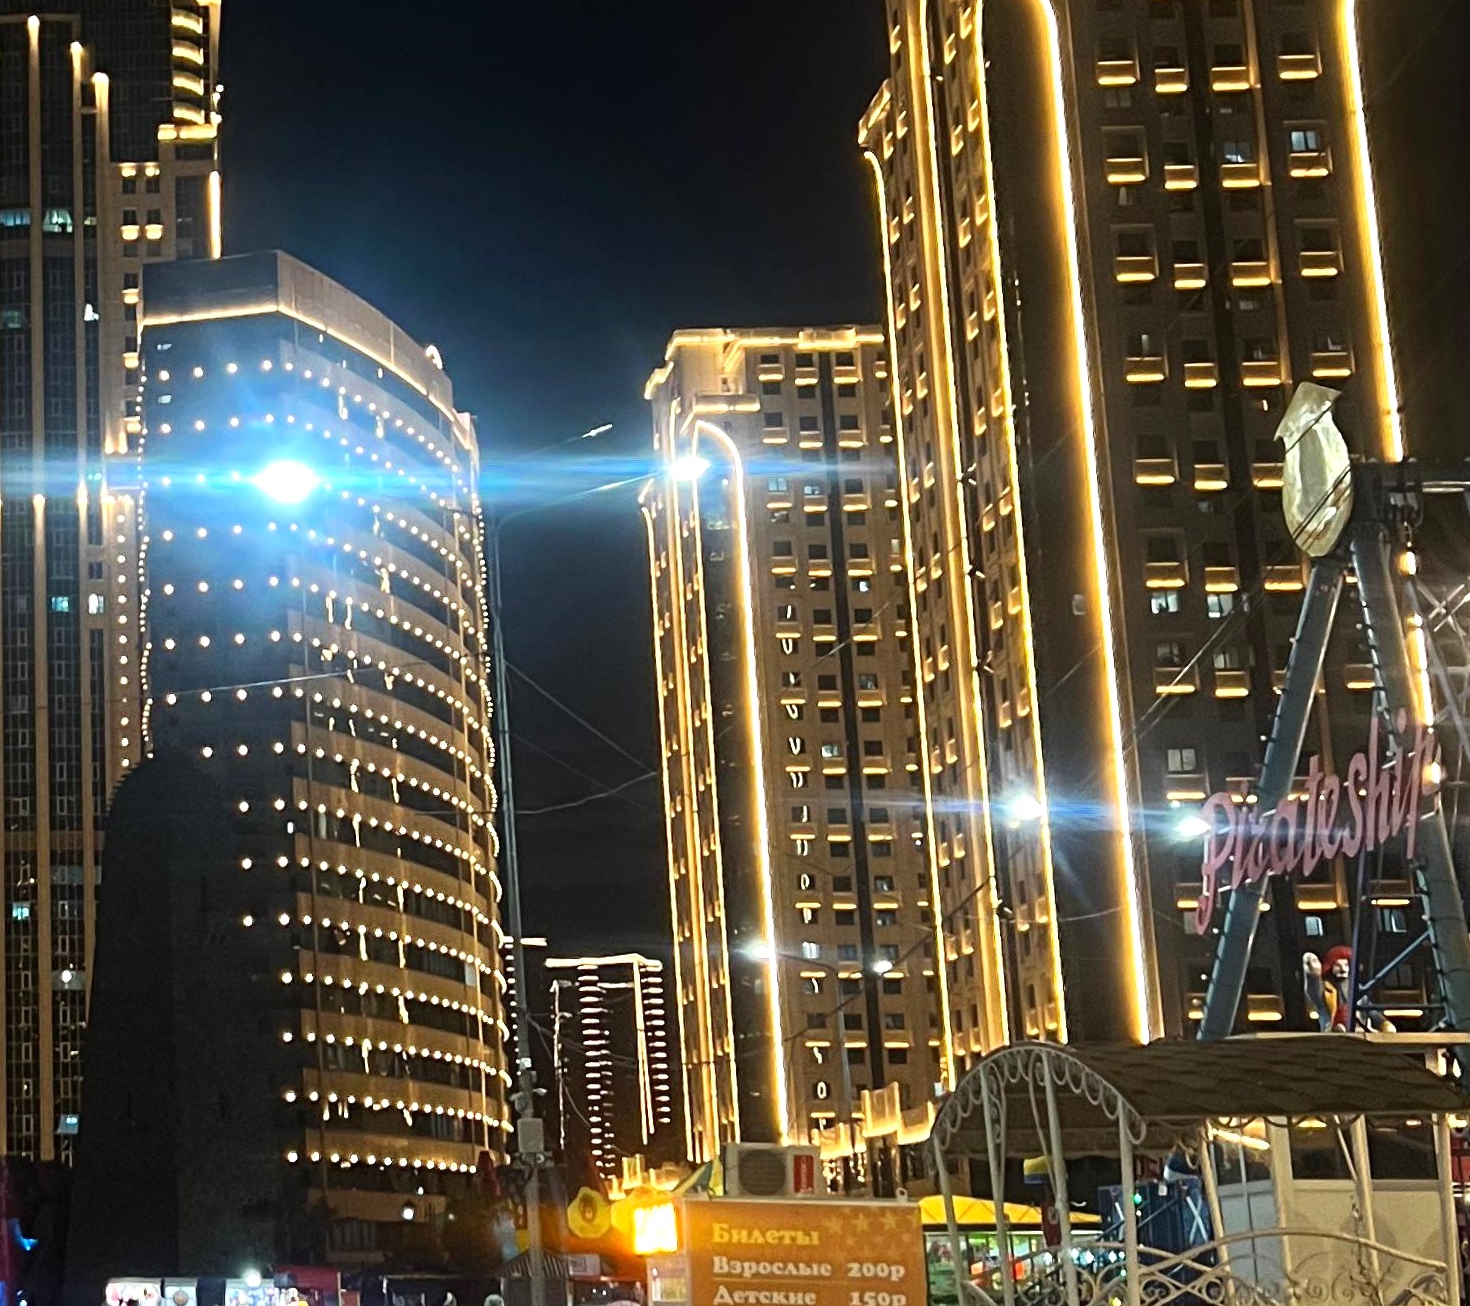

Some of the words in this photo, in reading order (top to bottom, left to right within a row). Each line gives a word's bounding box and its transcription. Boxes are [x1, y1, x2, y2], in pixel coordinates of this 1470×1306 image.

[712, 1223, 820, 1246] Билеты
[712, 1255, 832, 1278] Взрослые
[846, 1262, 906, 1281] 200р
[713, 1285, 817, 1306] Детские
